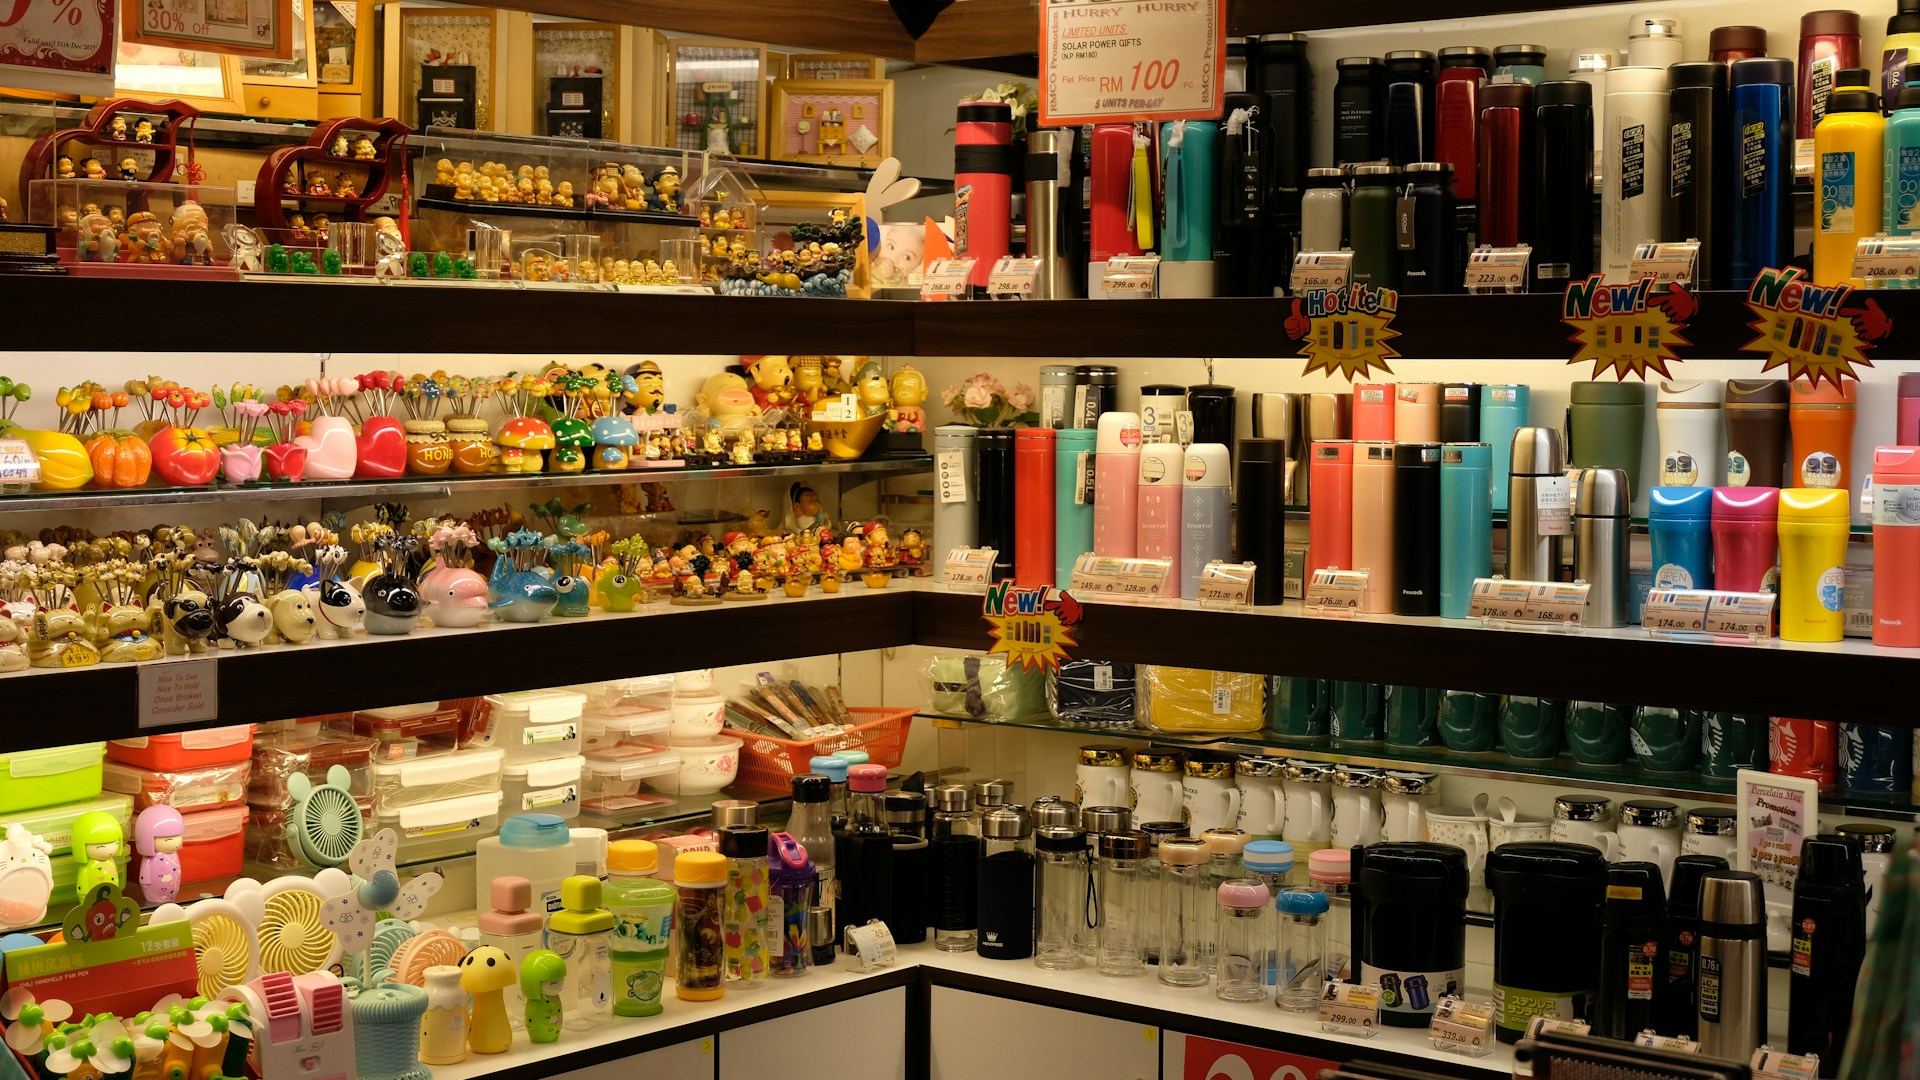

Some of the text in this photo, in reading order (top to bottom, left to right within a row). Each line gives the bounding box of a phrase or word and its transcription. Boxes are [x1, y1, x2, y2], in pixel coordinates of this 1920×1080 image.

[1063, 1, 1200, 18] HURRY HURRY
[148, 10, 210, 35] 30% Off
[1062, 24, 1127, 37] LIMITED UNITS
[23, 37, 40, 45] Valid
[41, 39, 56, 47] until
[1050, 12, 1059, 69] Promotion
[1062, 38, 1142, 51] SOLAR POWER GIFTS
[1075, 51, 1098, 59] RM180)
[1201, 0, 1214, 104] RMCO Promotion
[1062, 58, 1194, 92] Flat Price RM 100 /PC
[1094, 100, 1101, 109] 5
[1102, 98, 1128, 109] UNITS
[1867, 267, 1897, 276] 208.00
[1478, 274, 1505, 282] 223.00
[998, 282, 1018, 290] 298.00
[1308, 282, 1398, 315] Hot item
[1565, 275, 1655, 319] New!
[1751, 267, 1852, 318] New!
[846, 397, 850, 406] 1
[845, 410, 852, 419] 2
[1086, 401, 1096, 424] 0.4L
[1143, 407, 1155, 426] 3
[1179, 414, 1187, 433] 3
[1085, 469, 1095, 493] 0.5L
[952, 573, 972, 581] 178.00
[1660, 570, 1687, 582] OPEN
[1080, 582, 1101, 590] 149.00
[1124, 584, 1146, 592] 128.00
[984, 579, 1049, 616] New!
[1208, 590, 1230, 598] 171.00
[1319, 597, 1343, 605] 176.00
[1482, 608, 1507, 617] 178.00
[1538, 611, 1563, 620] 168.00
[1657, 619, 1685, 628] 174.00
[1719, 622, 1748, 631] 174.00
[158, 673, 198, 683] Nice To See
[156, 685, 171, 693] Nice
[184, 682, 199, 691] Hold
[153, 692, 202, 703] Once Broken
[151, 702, 204, 715] Consider Sold
[1751, 785, 1802, 803] Porcelain Mug
[1755, 797, 1797, 816] Promotion
[1751, 847, 1758, 858] 3
[17, 953, 85, 978] 辣椒风扇笔
[35, 975, 63, 985] HANDHELD
[1512, 996, 1556, 1011] ステンレス
[1330, 1013, 1357, 1025] 299.00
[1442, 1030, 1466, 1043] 339.00
